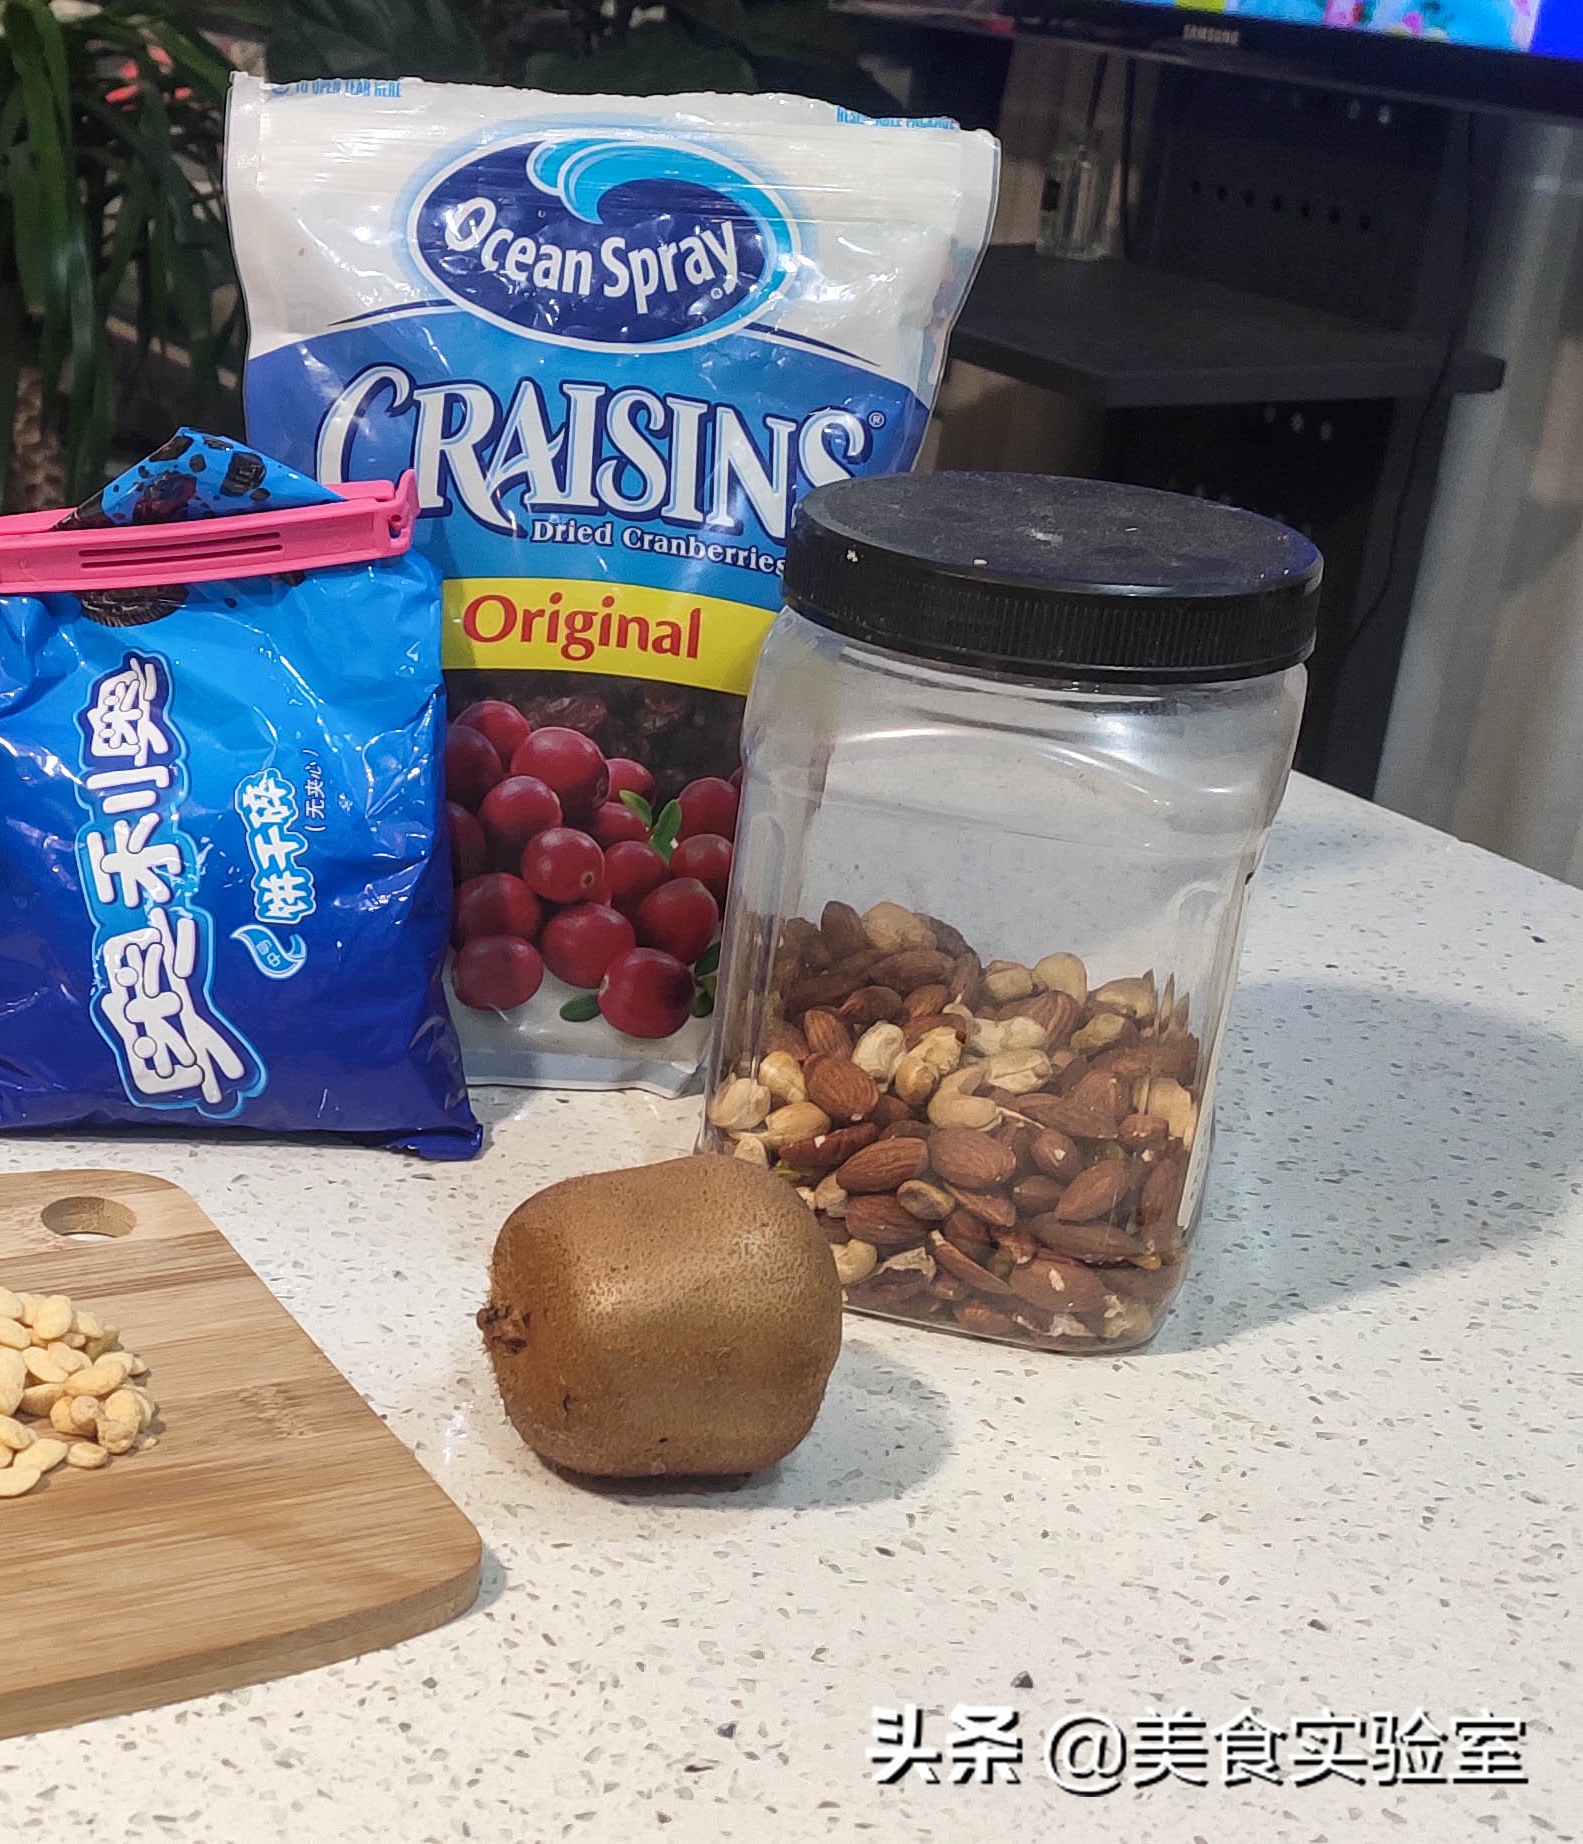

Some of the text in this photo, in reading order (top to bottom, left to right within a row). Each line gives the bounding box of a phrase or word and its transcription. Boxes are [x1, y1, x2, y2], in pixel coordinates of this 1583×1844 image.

[444, 197, 738, 314] Ocean Spray
[531, 520, 786, 575] Dried Cranberries
[463, 592, 701, 660] Original
[87, 659, 245, 1103] 奥利奥
[243, 773, 310, 918] 饼干碎
